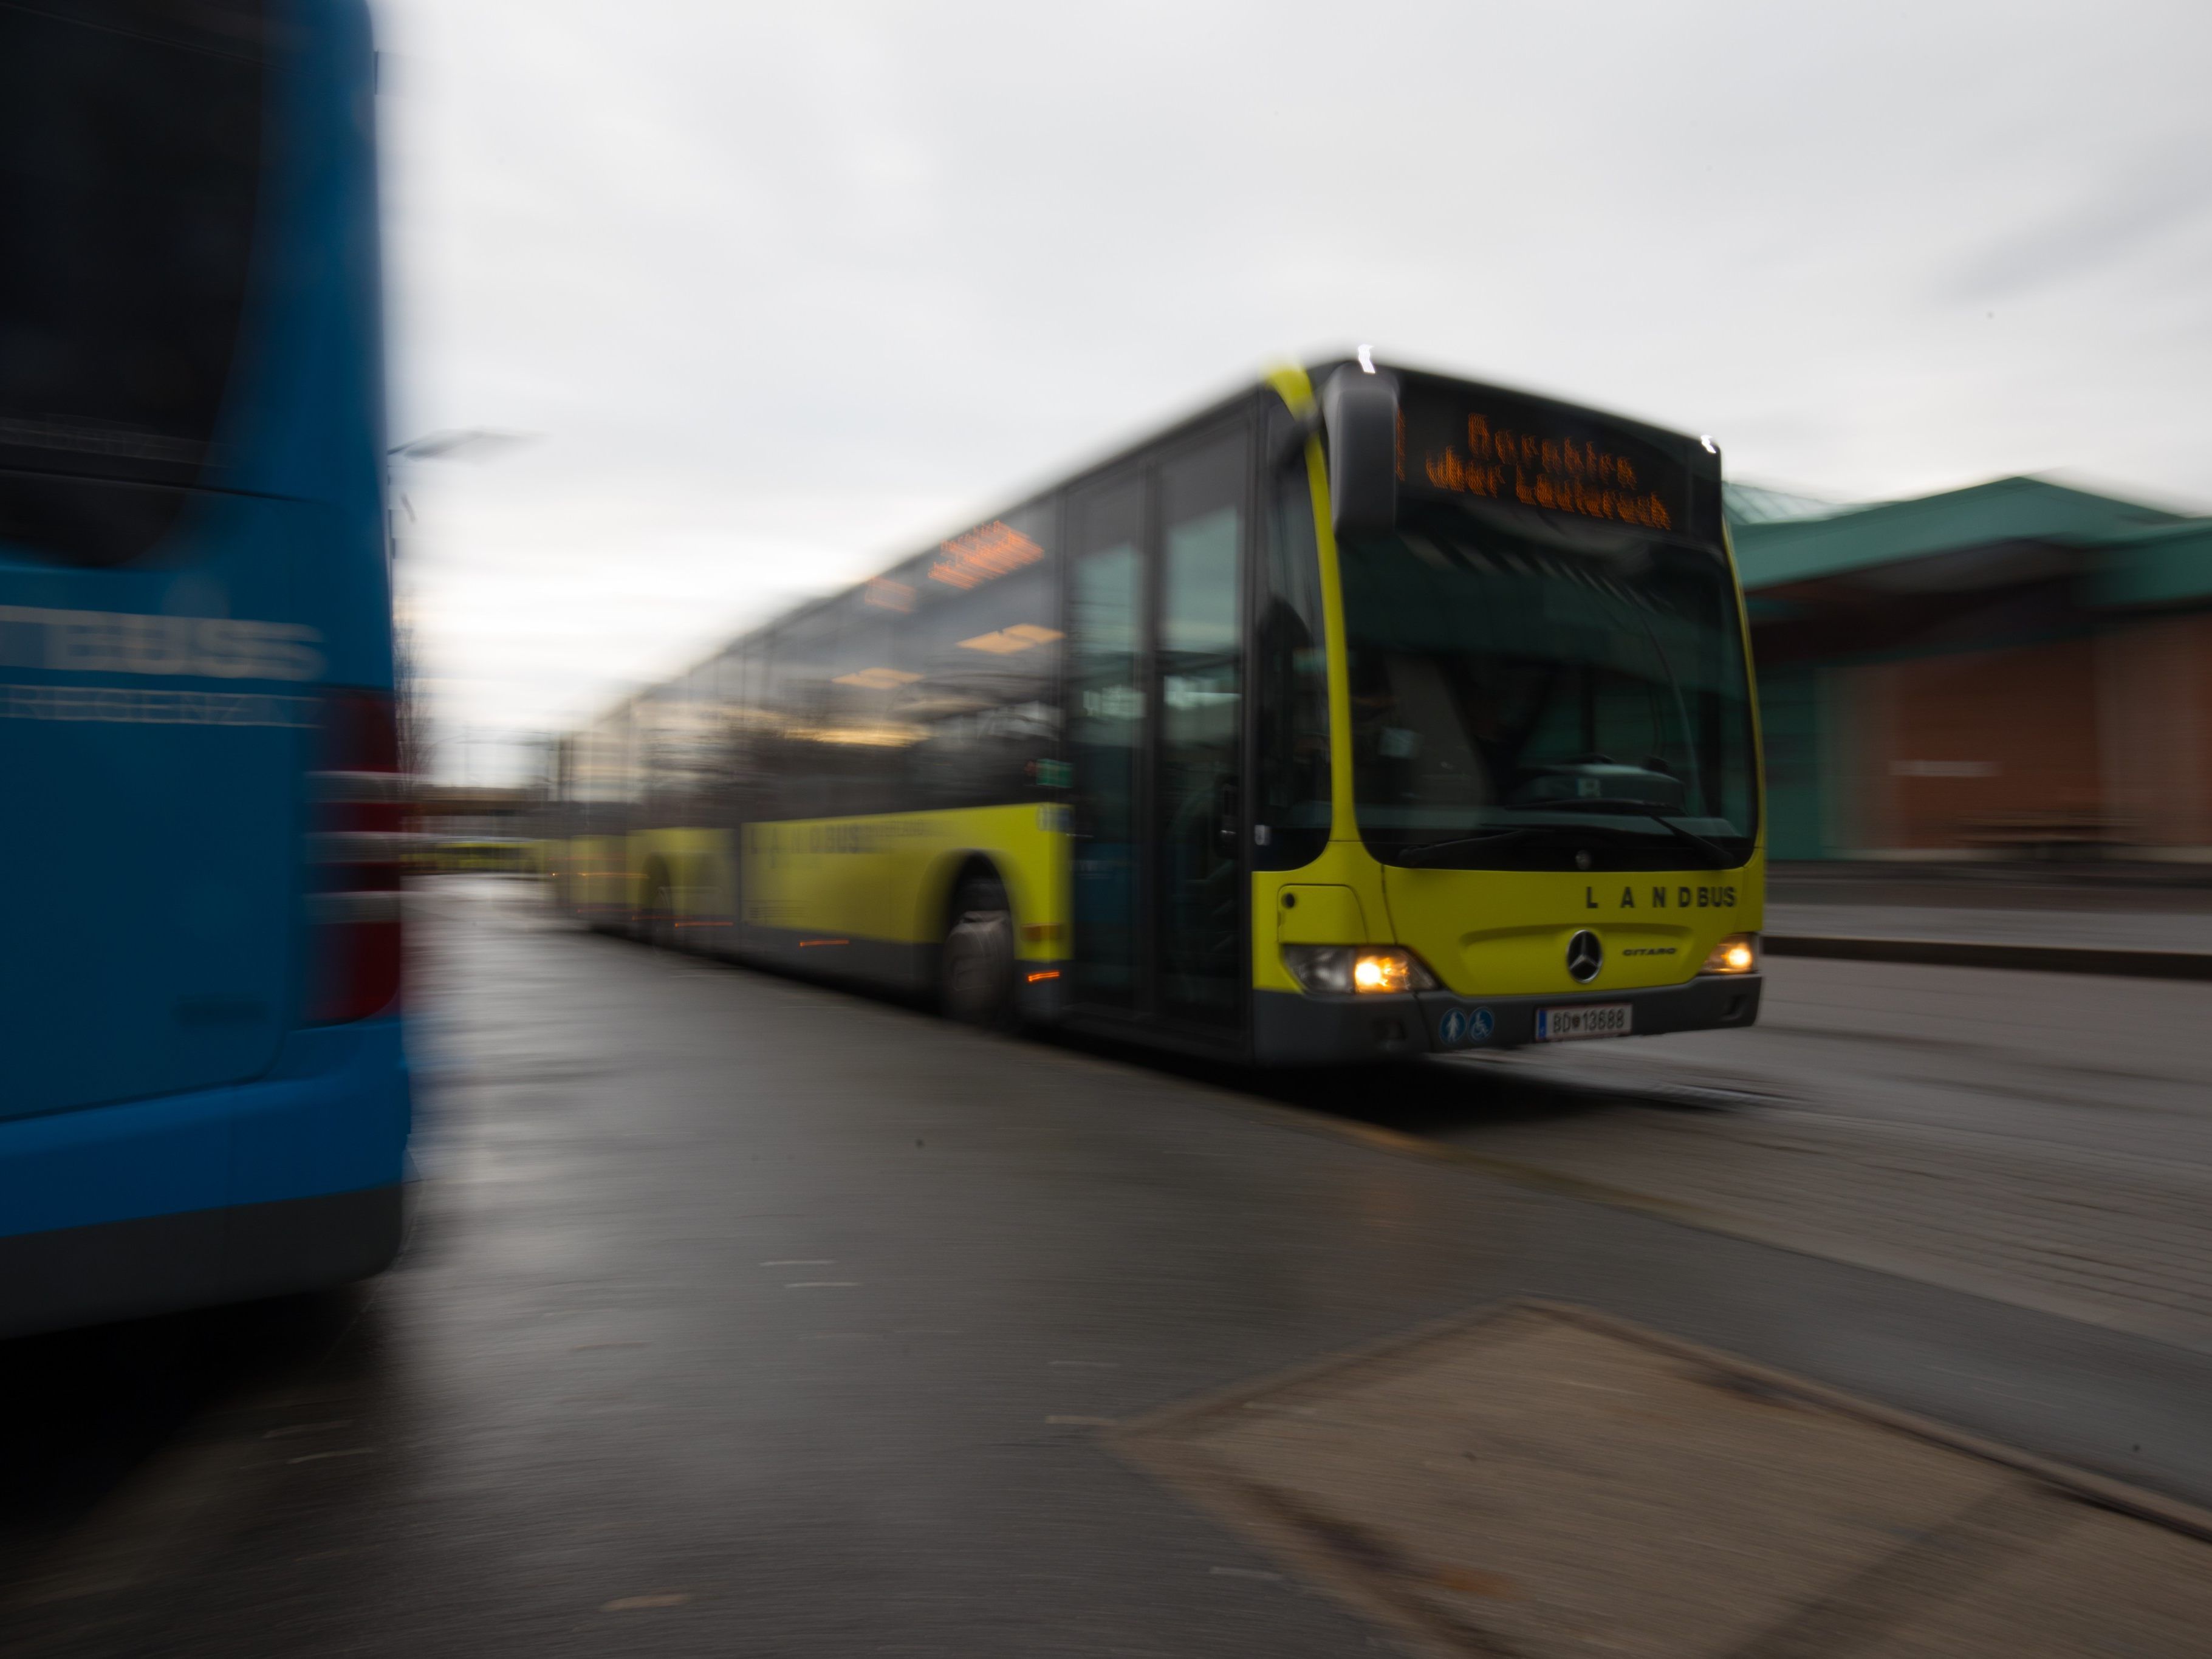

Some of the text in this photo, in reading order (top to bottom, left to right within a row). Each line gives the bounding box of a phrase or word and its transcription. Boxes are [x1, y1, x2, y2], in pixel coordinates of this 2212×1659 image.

[1586, 886, 1736, 908] LANDBUS
[1623, 948, 1677, 956] CITARO
[1553, 1012, 1570, 1033] BD
